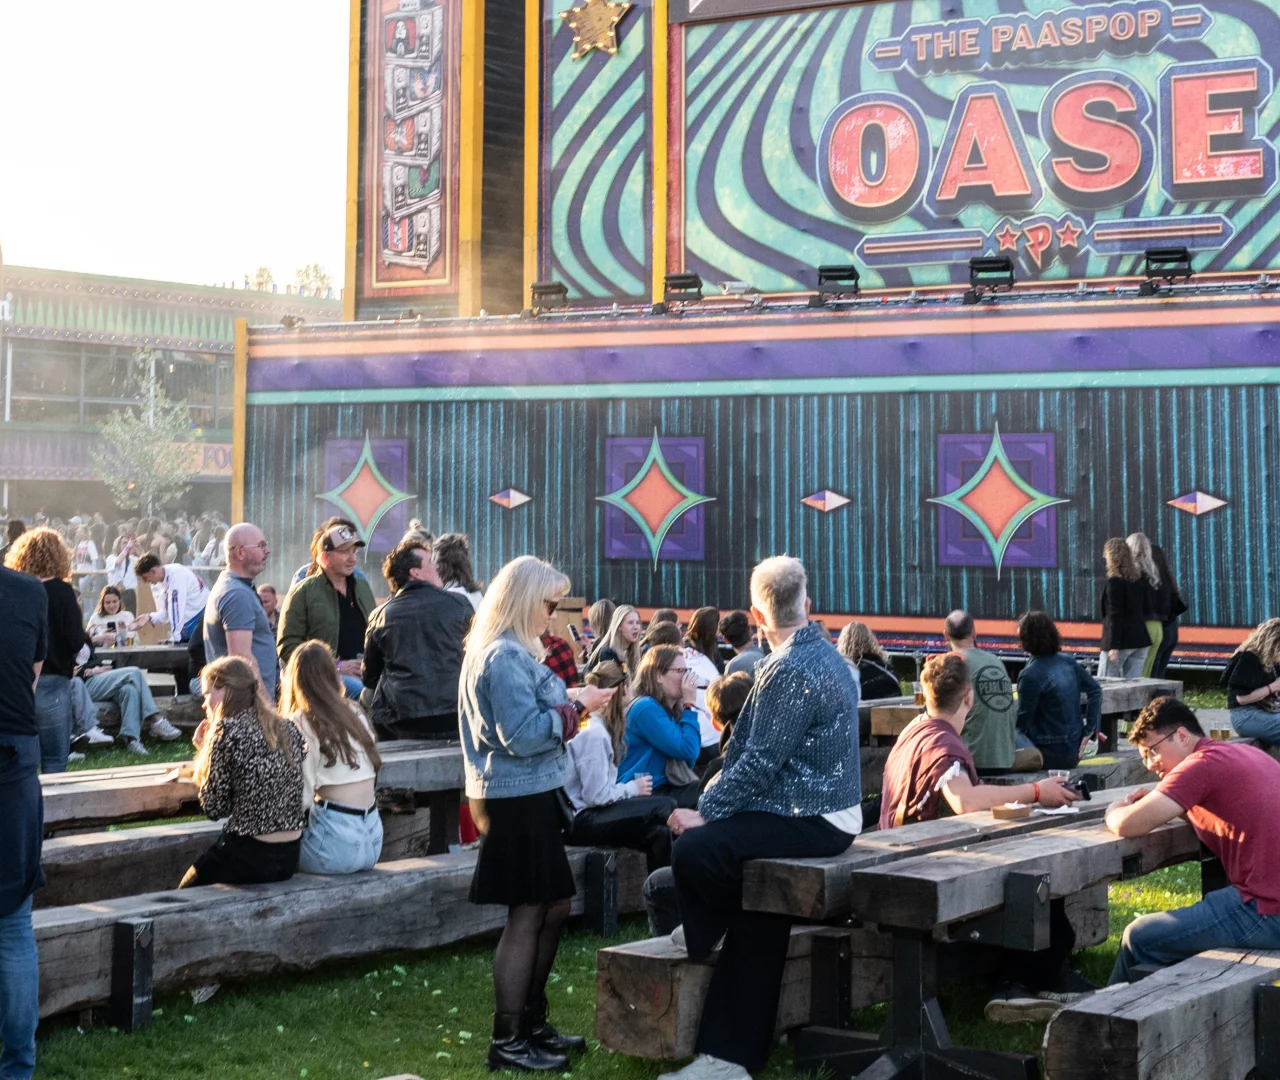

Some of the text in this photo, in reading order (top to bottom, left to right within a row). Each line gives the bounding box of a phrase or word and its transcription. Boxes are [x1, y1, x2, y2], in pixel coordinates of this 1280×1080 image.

[910, 9, 1163, 62] THE PAASPOP
[828, 66, 1266, 210] OASE
[978, 681, 1003, 694] PEARL
